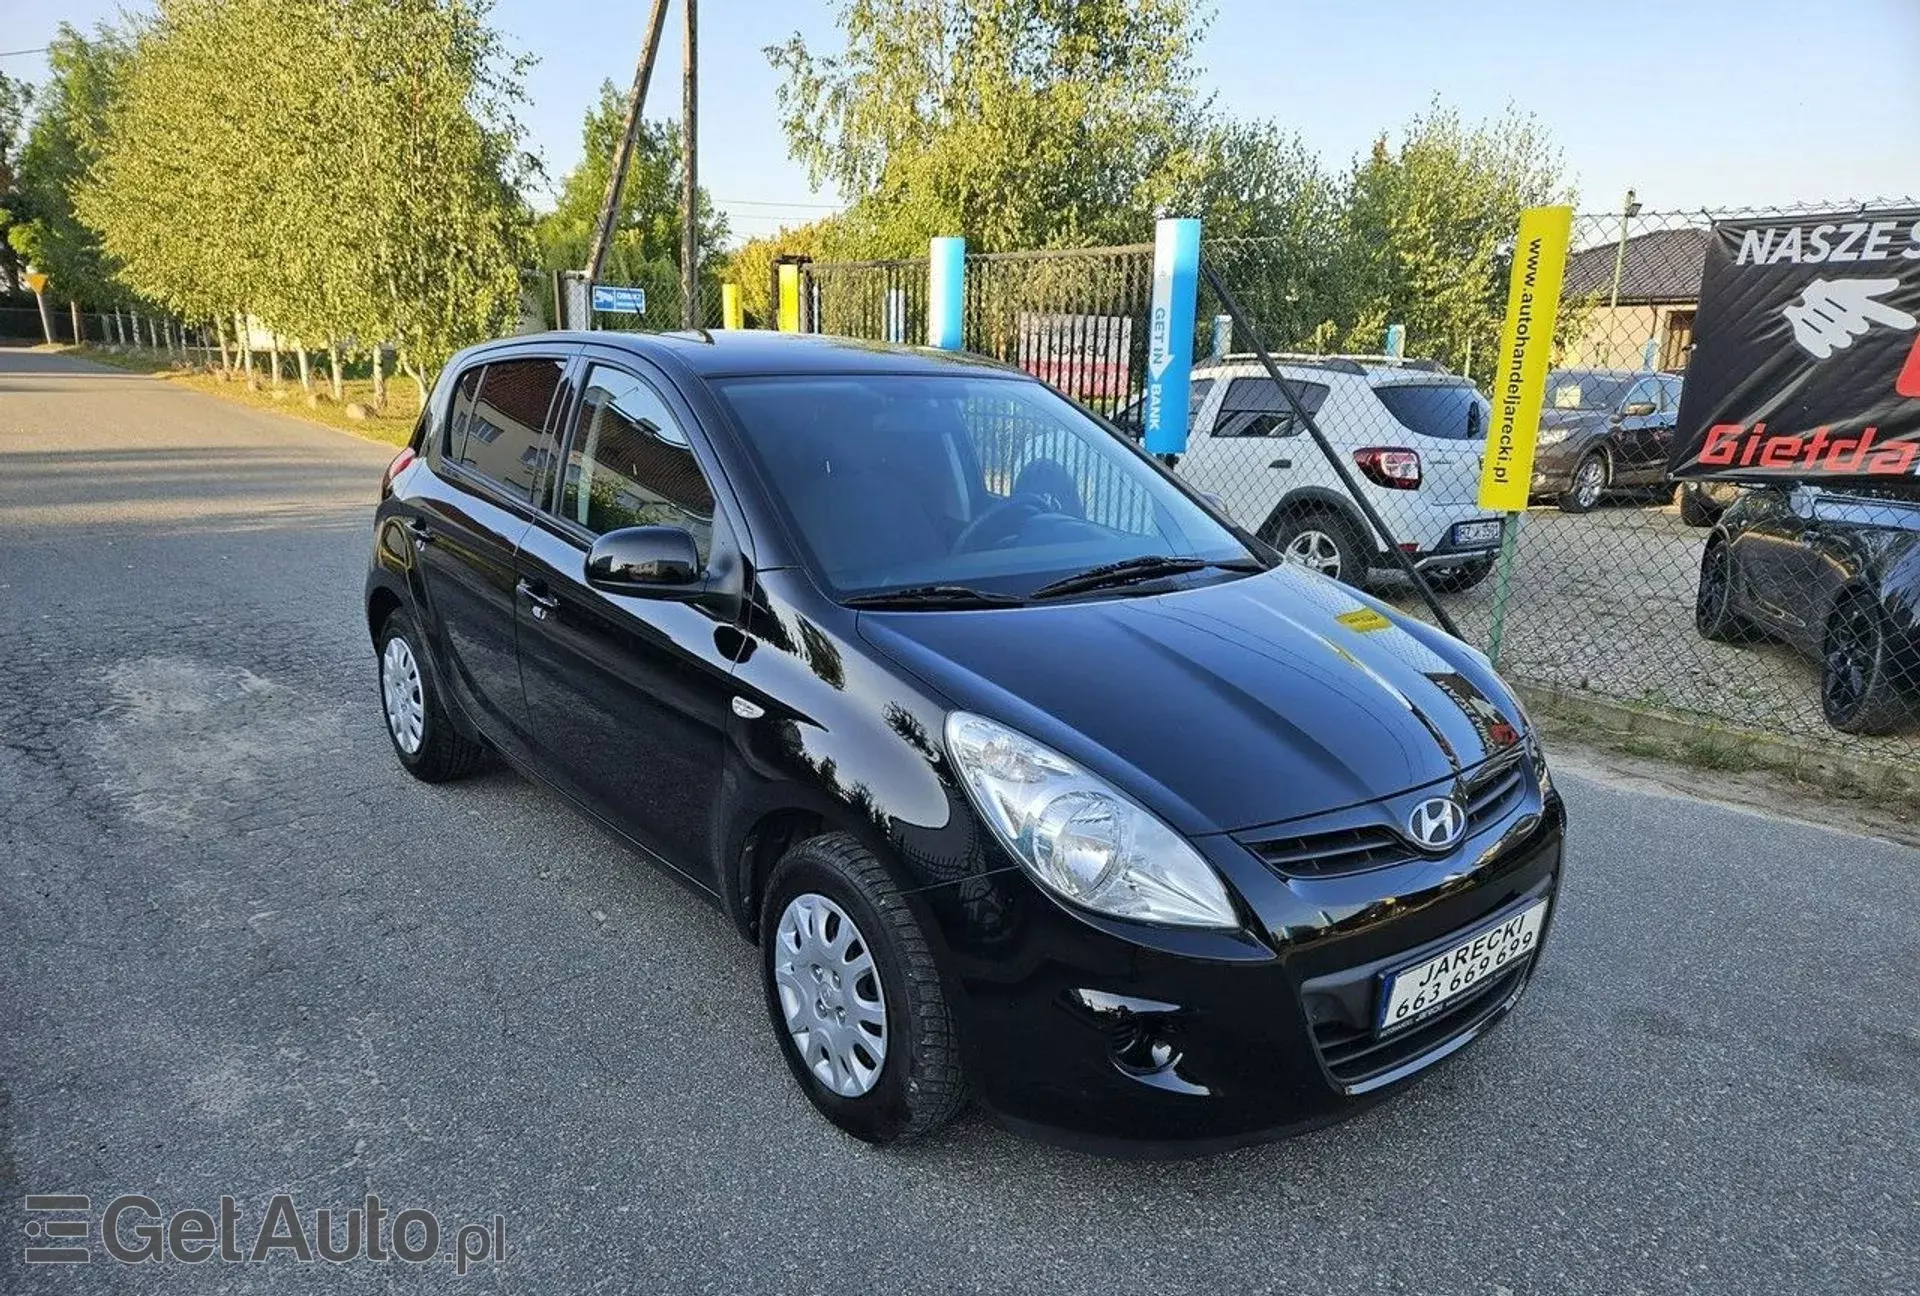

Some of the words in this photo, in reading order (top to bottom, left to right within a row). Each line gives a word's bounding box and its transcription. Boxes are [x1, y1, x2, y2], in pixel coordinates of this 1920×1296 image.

[1736, 222, 1898, 265] NASZE
[1154, 308, 1165, 343] GET
[1051, 344, 1106, 357] KOMSU
[1153, 348, 1163, 365] IN
[1494, 238, 1541, 484] www.autohandeljarecki.pl
[1149, 384, 1162, 431] BANK
[1419, 915, 1526, 987] JARECKI
[1396, 982, 1441, 1019] 663
[1450, 956, 1490, 992] 669
[1496, 931, 1533, 966] 699
